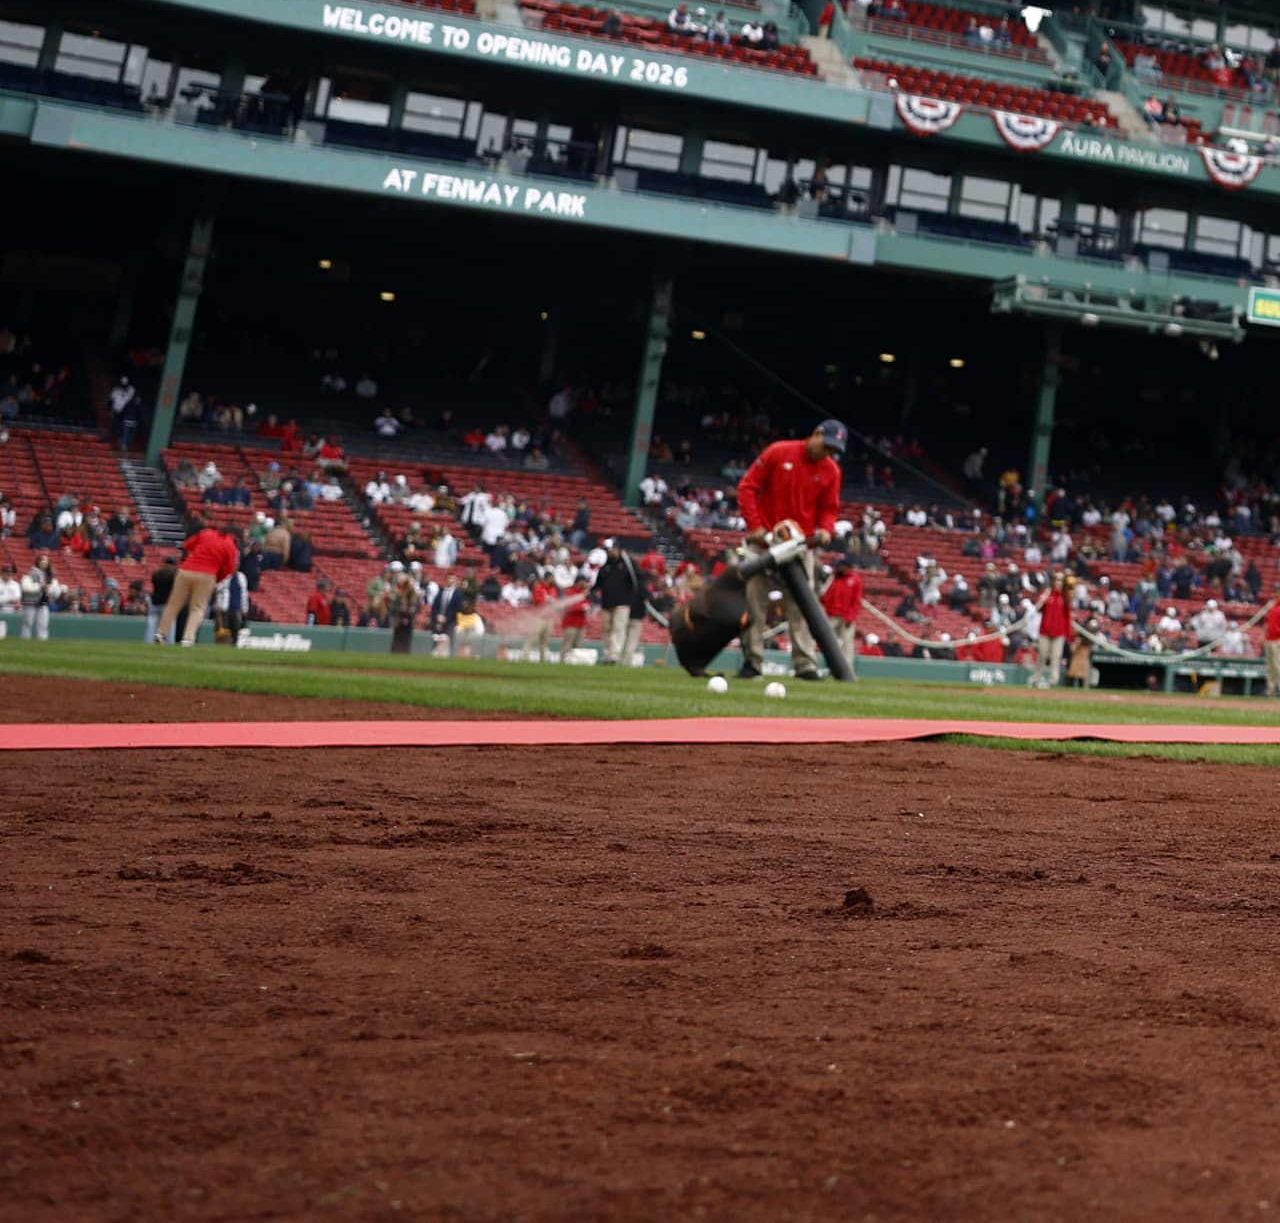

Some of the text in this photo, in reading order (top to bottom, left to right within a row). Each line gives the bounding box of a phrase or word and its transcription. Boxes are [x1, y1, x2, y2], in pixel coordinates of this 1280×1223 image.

[323, 5, 688, 87] WELCOME TO OPENING DAY 2026
[1117, 144, 1190, 173] PAVILION
[384, 168, 586, 217] AT FENWAY PARK
